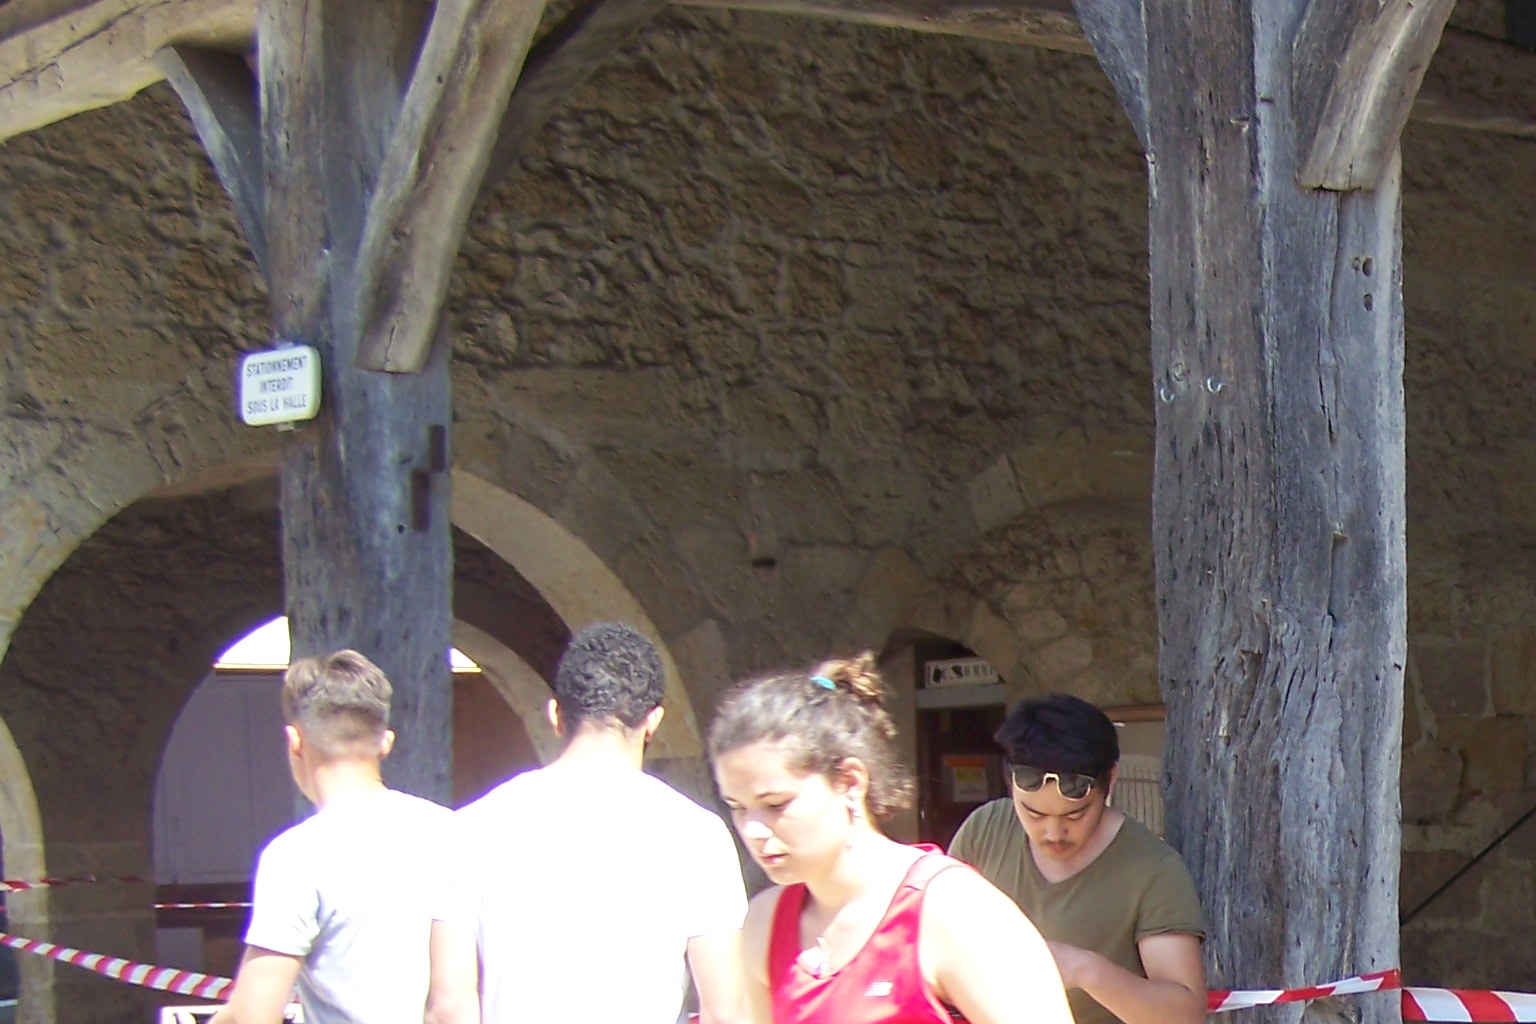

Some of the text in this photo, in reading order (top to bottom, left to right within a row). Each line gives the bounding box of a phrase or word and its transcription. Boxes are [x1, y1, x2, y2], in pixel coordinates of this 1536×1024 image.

[247, 355, 307, 377] STATIONNEMENT
[261, 377, 293, 393] INTERDIT
[247, 394, 307, 415] SOUS LA HALLE
